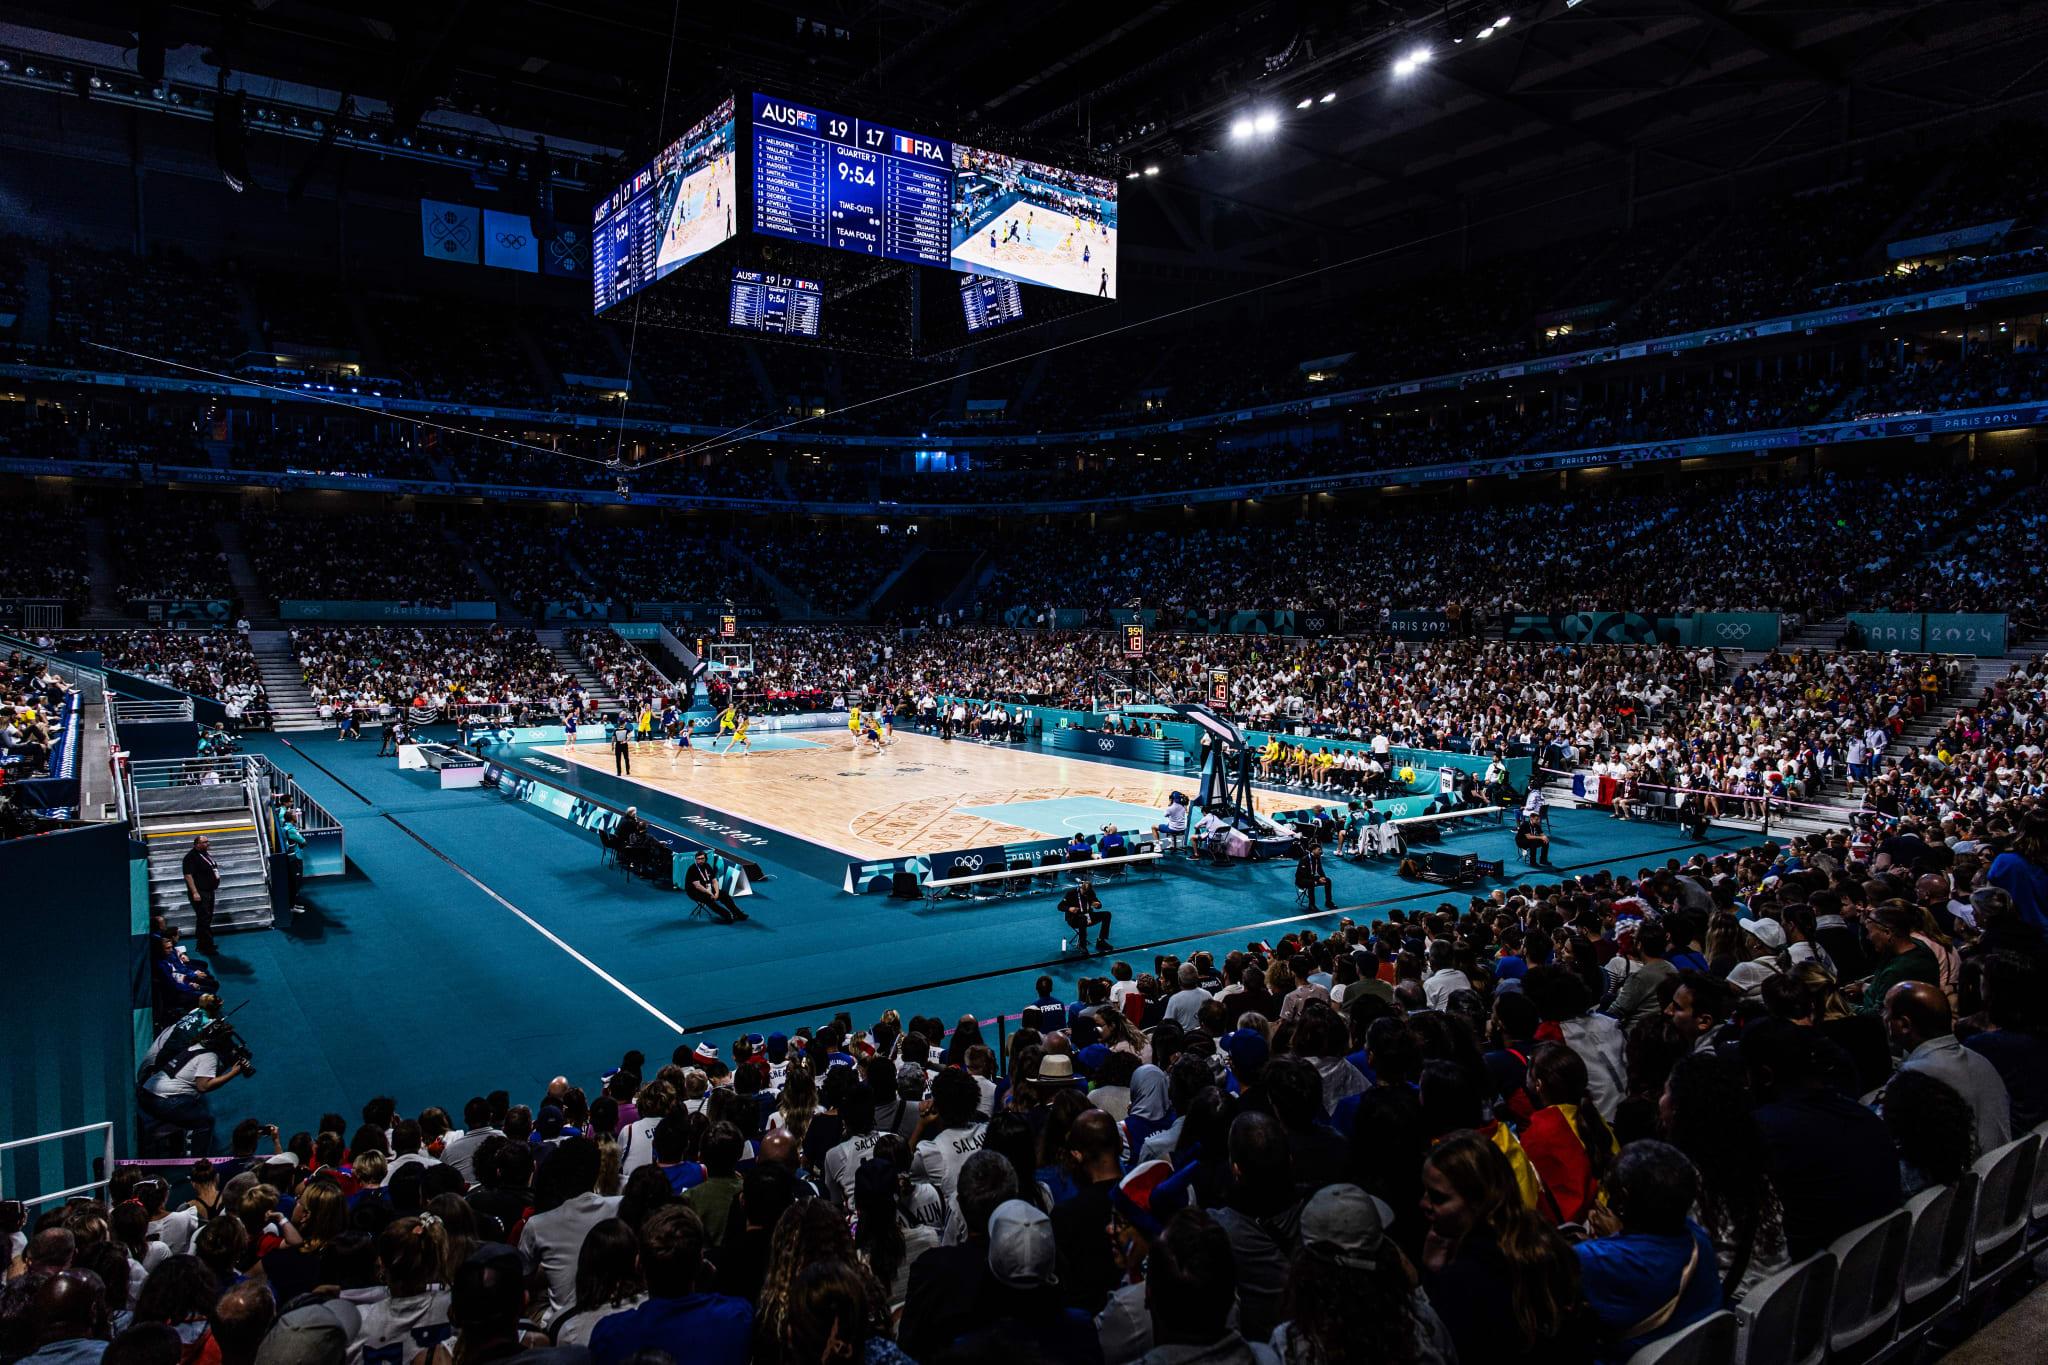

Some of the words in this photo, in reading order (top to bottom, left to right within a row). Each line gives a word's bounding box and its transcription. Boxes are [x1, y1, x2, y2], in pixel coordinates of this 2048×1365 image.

[762, 103, 796, 126] AUS
[829, 120, 848, 138] 19
[866, 129, 884, 147] 17
[914, 141, 944, 162] FRA
[766, 138, 794, 149] MELBOURNE
[766, 146, 788, 155] WALLACE
[766, 153, 784, 161] TALBOT
[837, 146, 870, 161] QUARTER
[838, 162, 875, 187] 9:54
[595, 204, 604, 225] AUS
[613, 193, 620, 210] 19
[624, 183, 631, 201] 17
[640, 168, 651, 188] FRA
[839, 201, 873, 214] TIME-OUTS
[616, 222, 629, 243] 9:54
[837, 227, 855, 237] TEAM
[855, 231, 876, 242] FOULS
[839, 239, 845, 247] 0
[868, 244, 874, 252] 0
[736, 271, 752, 280] AUS
[804, 282, 819, 291] FRA
[768, 293, 786, 304] 9:54
[1984, 414, 2017, 424] 2024
[725, 623, 734, 632] 18
[1128, 627, 1142, 635] 9:54
[1392, 621, 1418, 632] ARiS
[1931, 627, 1992, 643] 2024
[1130, 637, 1141, 650] 18
[1214, 674, 1226, 682] 9:54
[1216, 685, 1226, 699] 18
[719, 829, 769, 846] 2024
[1041, 1003, 1062, 1014] FRANCE
[854, 1135, 883, 1152] SALAU
[953, 1132, 987, 1154] SALAU
[912, 1200, 942, 1225] AUN
